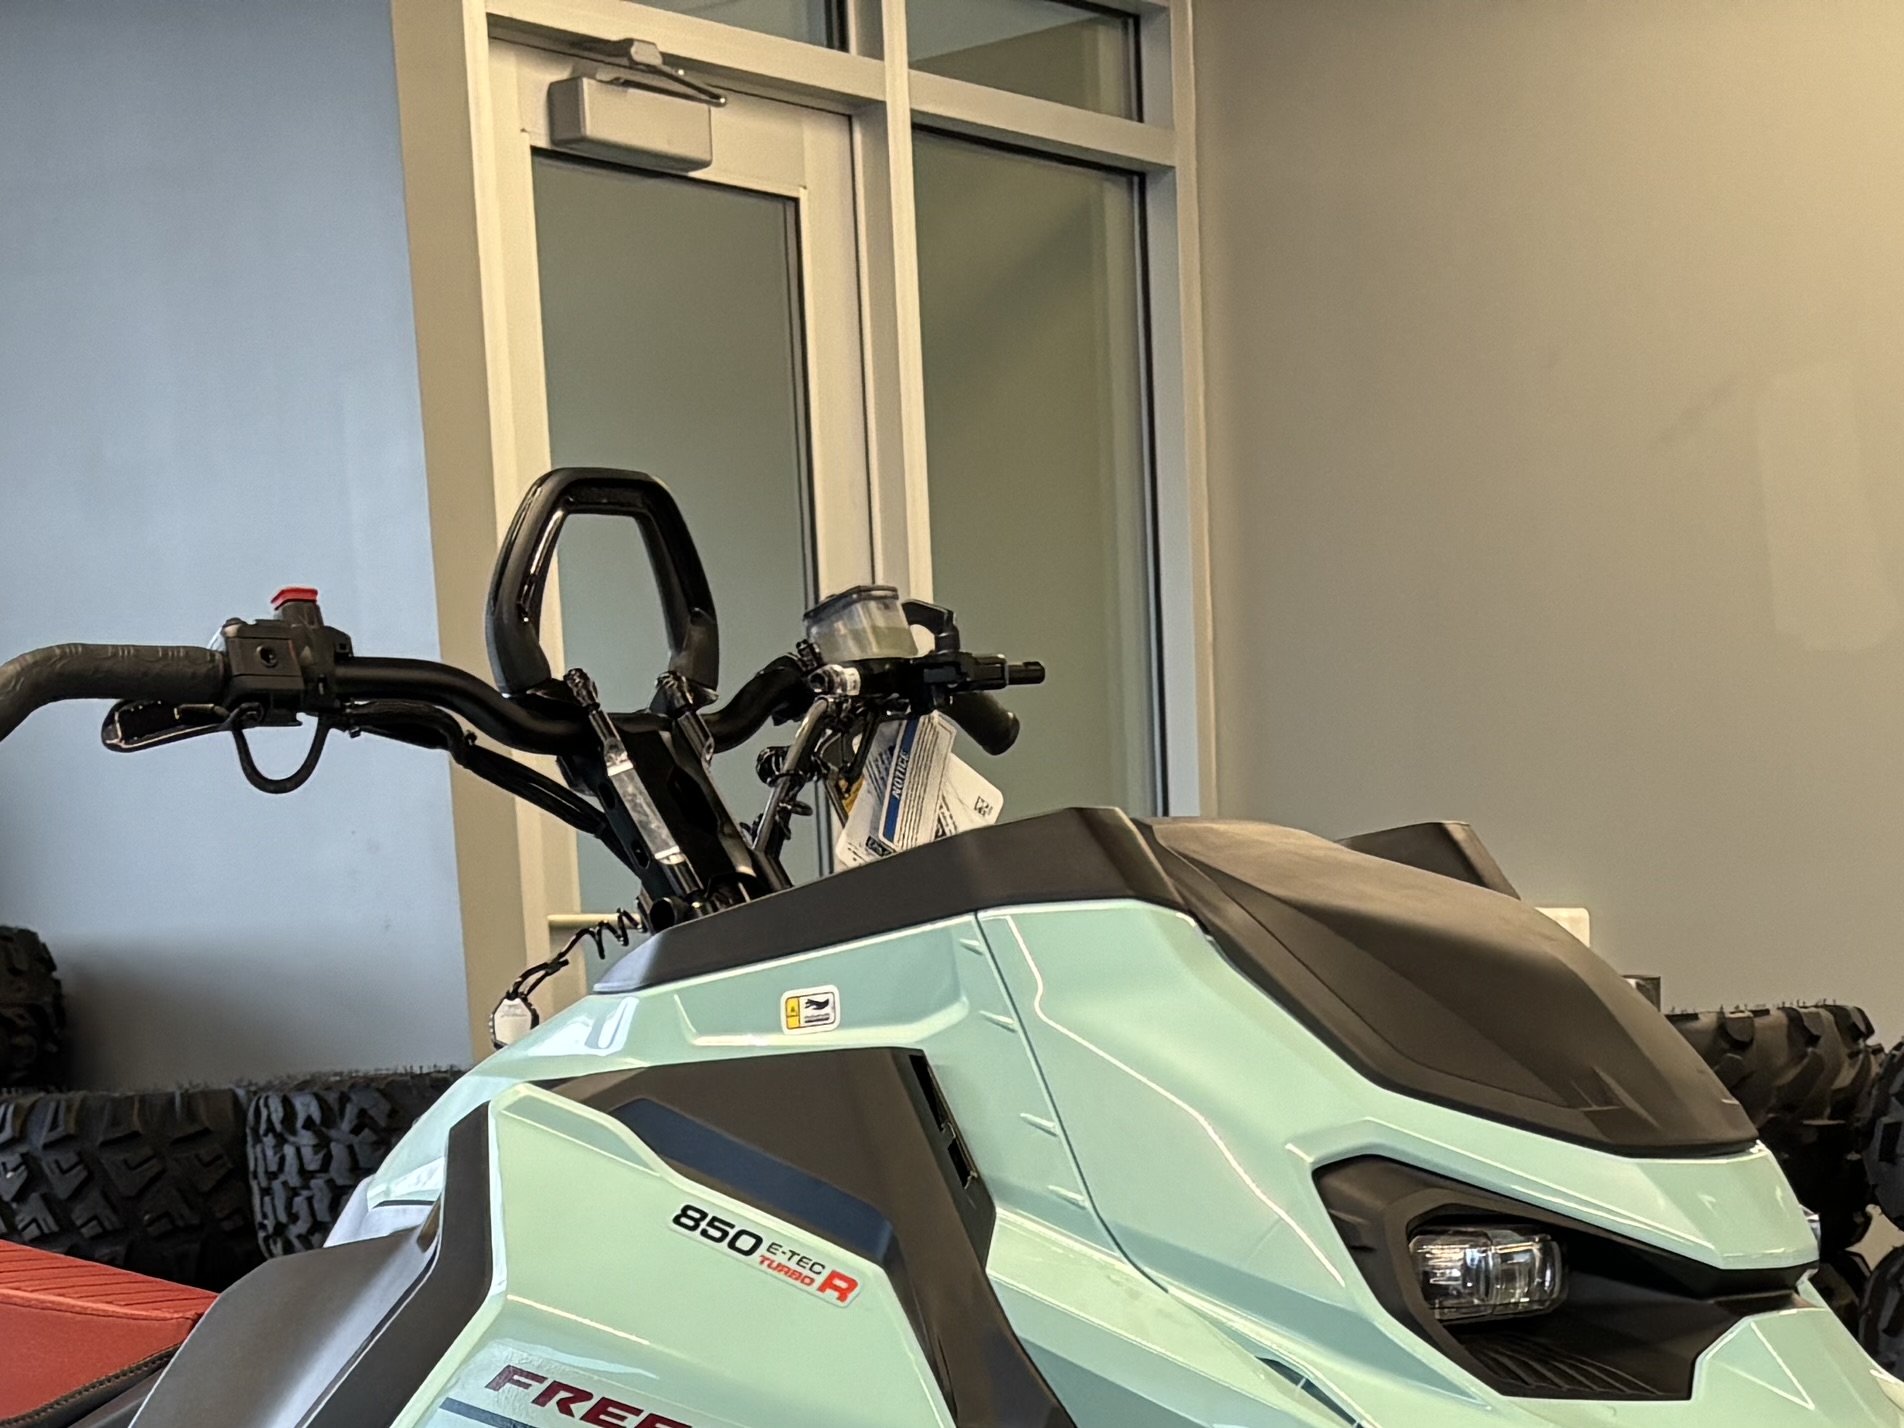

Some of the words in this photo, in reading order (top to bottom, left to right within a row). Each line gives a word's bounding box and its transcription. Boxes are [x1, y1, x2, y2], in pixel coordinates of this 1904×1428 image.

[672, 1204, 764, 1257] 850
[766, 1241, 826, 1275] E-TEC
[759, 1255, 815, 1287] TURBO
[816, 1269, 859, 1303] R
